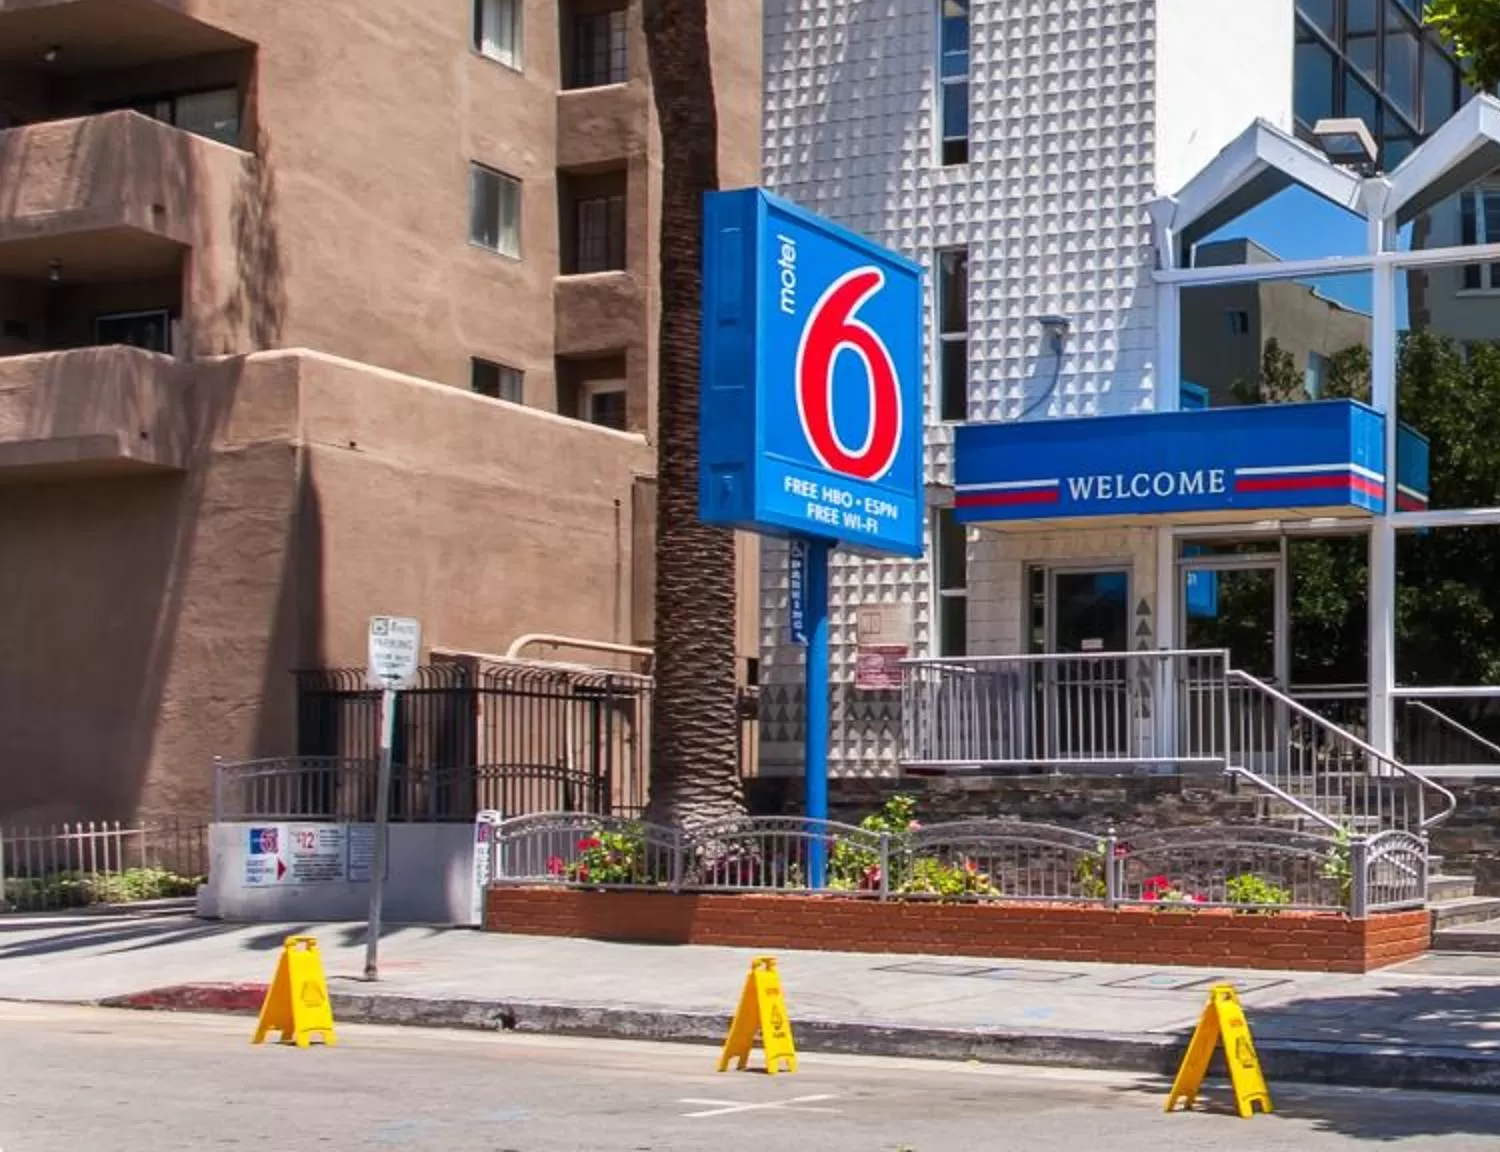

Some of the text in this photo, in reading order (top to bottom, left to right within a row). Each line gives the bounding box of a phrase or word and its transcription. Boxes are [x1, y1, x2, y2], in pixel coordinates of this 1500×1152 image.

[777, 233, 797, 315] motel
[795, 265, 903, 482] 6
[783, 475, 899, 520] FREE HBO ESPN
[1066, 468, 1226, 501] WELCOME
[807, 502, 841, 525] FREE
